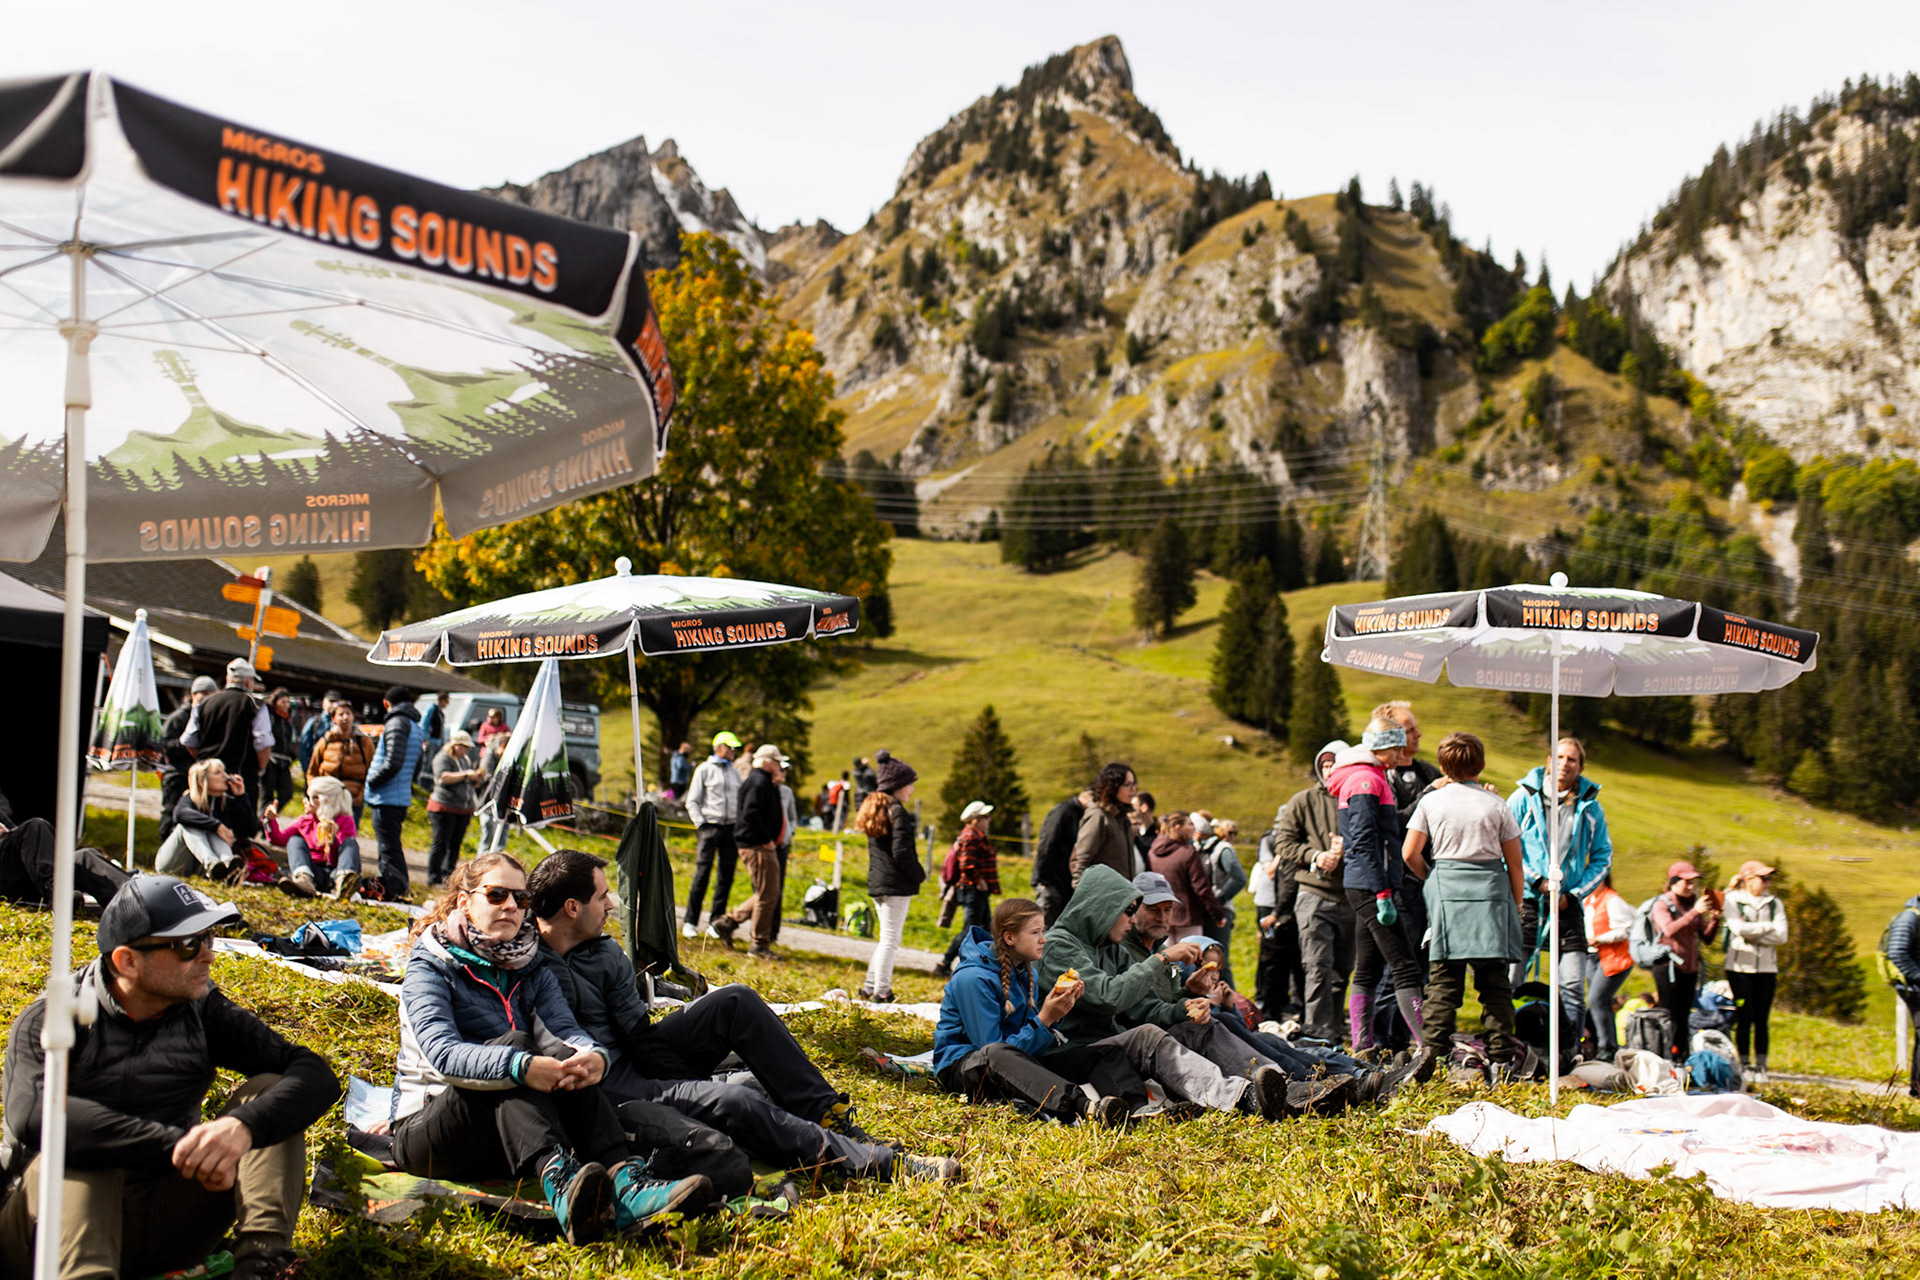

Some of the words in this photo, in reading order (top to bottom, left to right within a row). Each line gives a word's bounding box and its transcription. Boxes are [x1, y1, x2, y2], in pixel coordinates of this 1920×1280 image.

[222, 127, 324, 174] MIGROS
[216, 157, 382, 250] HIKING
[390, 204, 559, 293] SOUNDS
[1522, 599, 1560, 608] MIGROS
[671, 618, 703, 628] MIGROS
[1355, 613, 1397, 634] HIKING
[1397, 608, 1451, 631] SOUNDS
[1522, 607, 1583, 629] HIKING
[1587, 610, 1659, 632] SOUNDS
[477, 637, 531, 659] HIKING
[534, 634, 599, 656] SOUNDS
[478, 630, 512, 638] MIGROS
[674, 626, 723, 648] HIKING
[727, 621, 787, 643] SOUNDS
[1722, 622, 1760, 648] HIKING
[1760, 631, 1800, 659] SOUNDS
